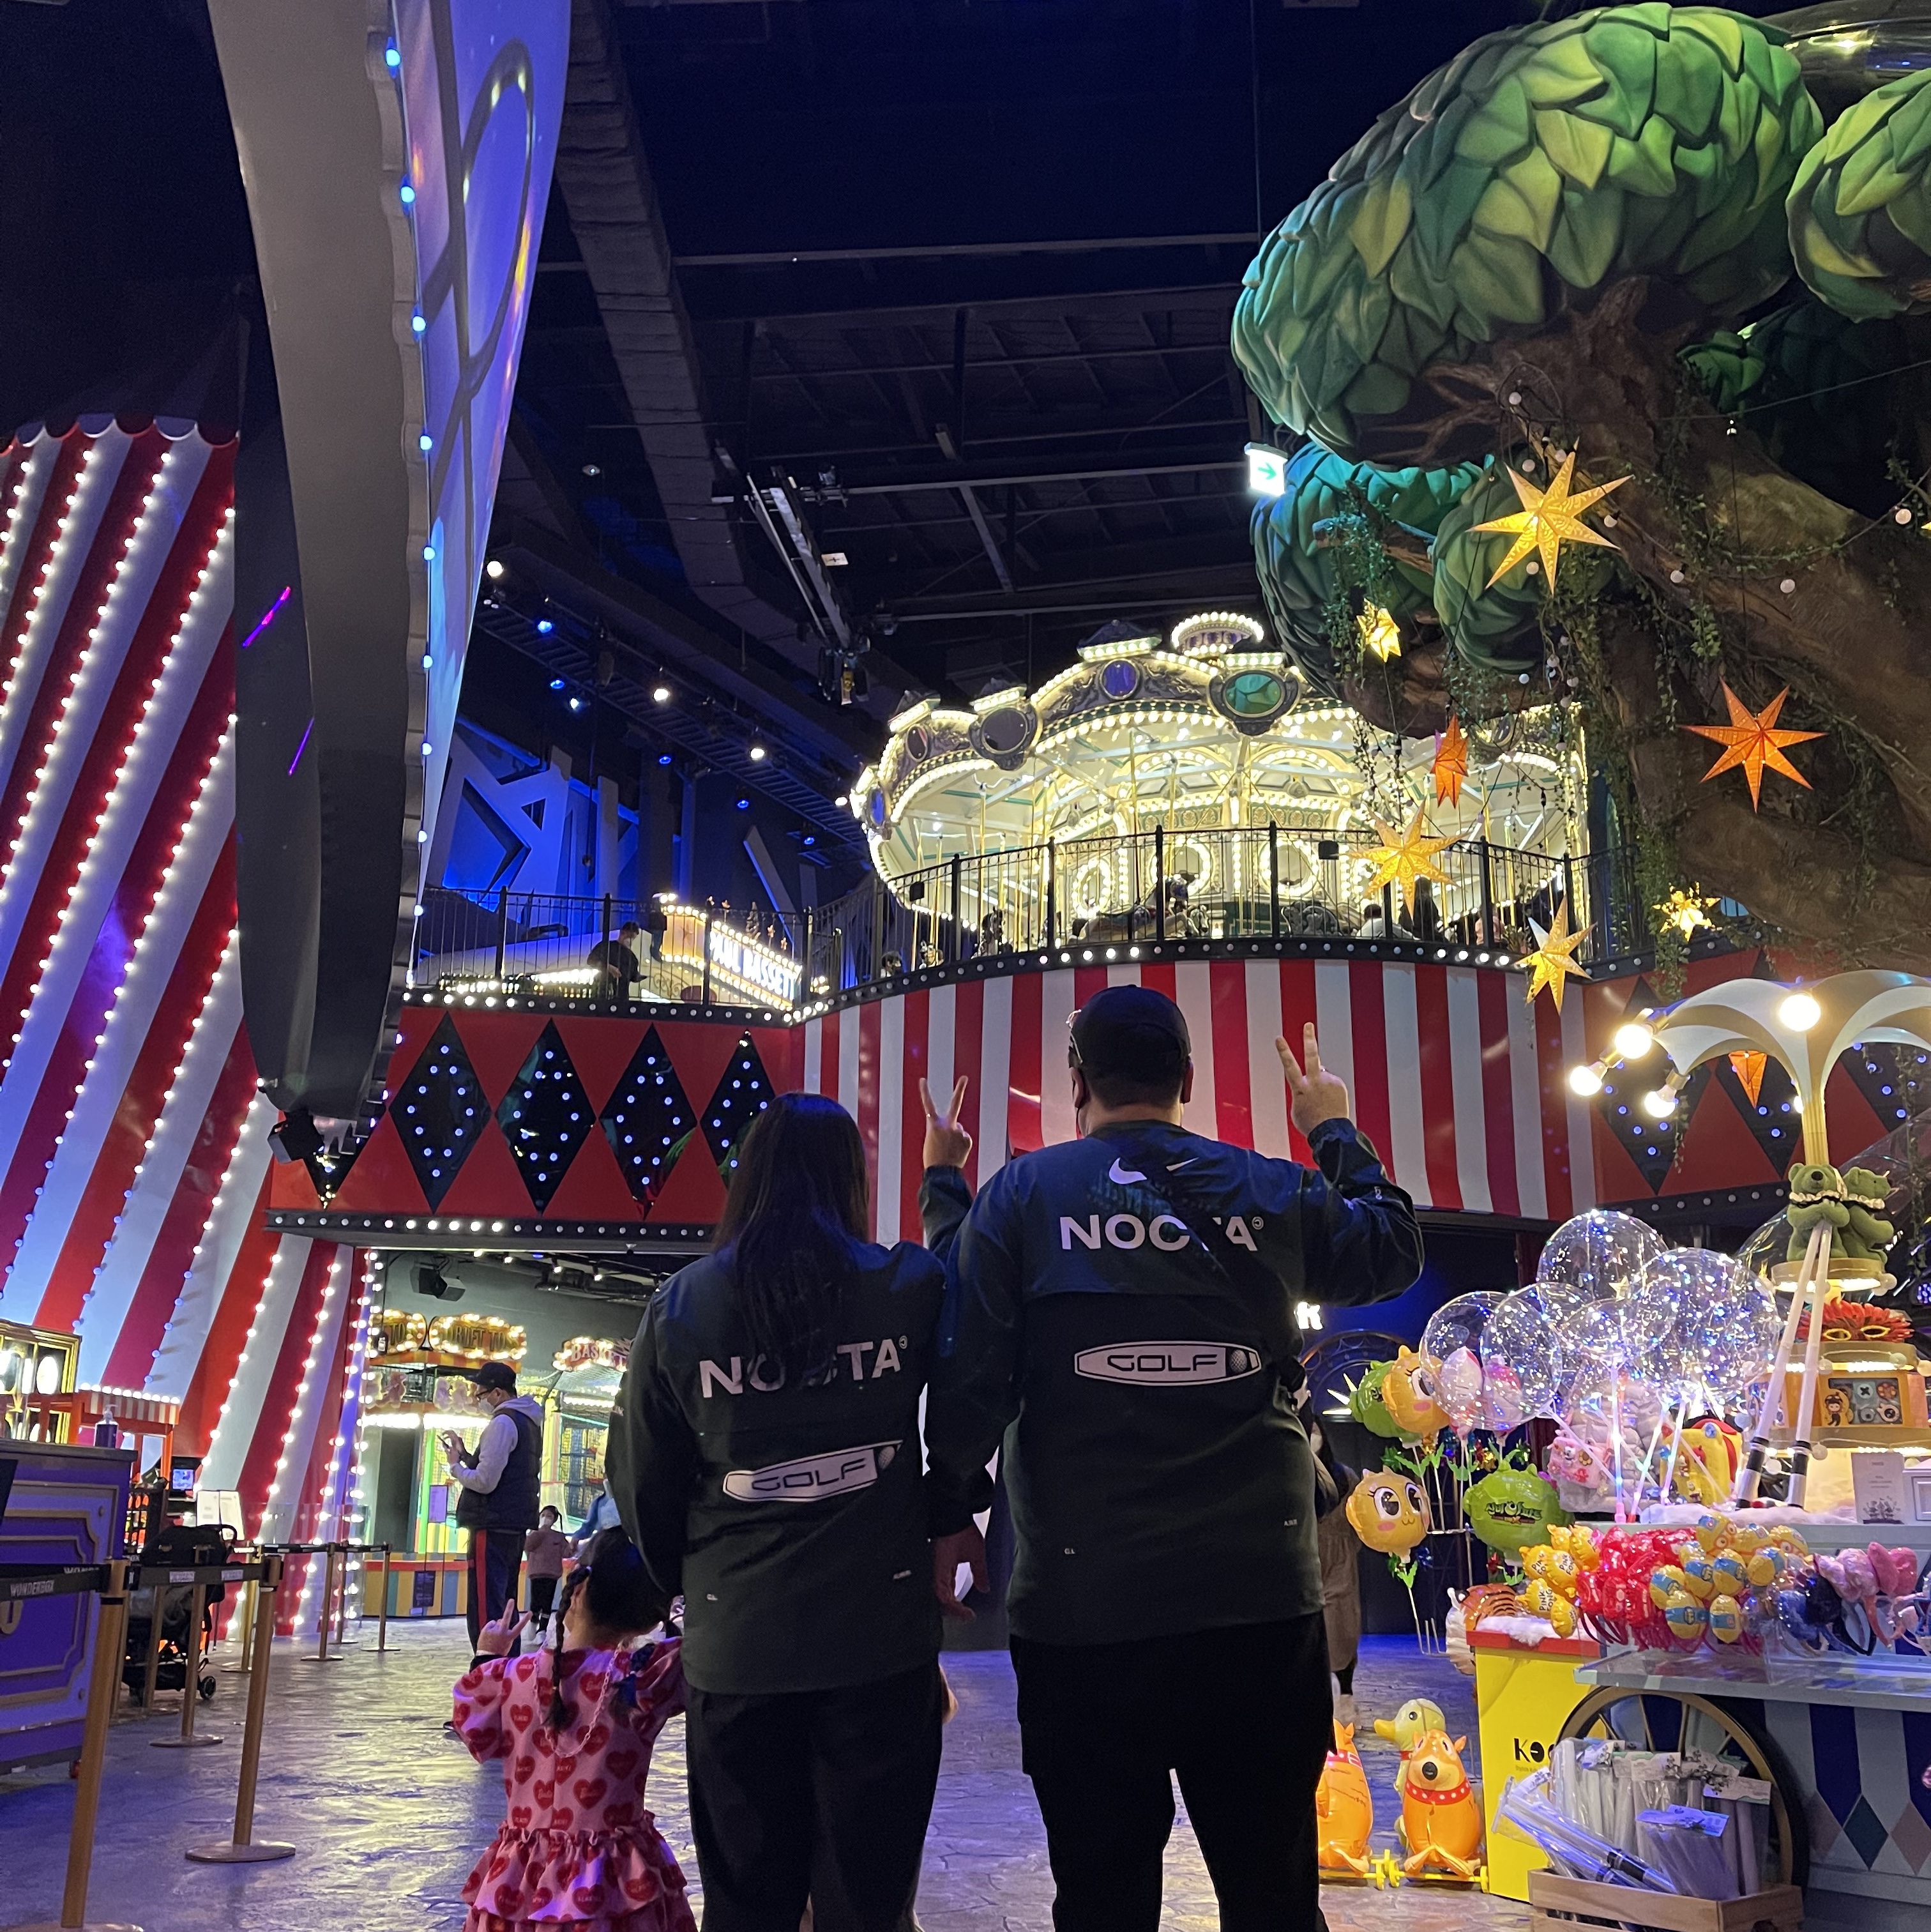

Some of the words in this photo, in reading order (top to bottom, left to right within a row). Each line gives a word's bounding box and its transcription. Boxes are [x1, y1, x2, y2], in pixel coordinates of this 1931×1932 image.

[1060, 1214, 1257, 1251] NOCA
[699, 1339, 900, 1398] NOTA
[1107, 1354, 1218, 1373] GOLF
[752, 1457, 867, 1491] GOLF
[10, 1579, 55, 1597] WONDERBOX
